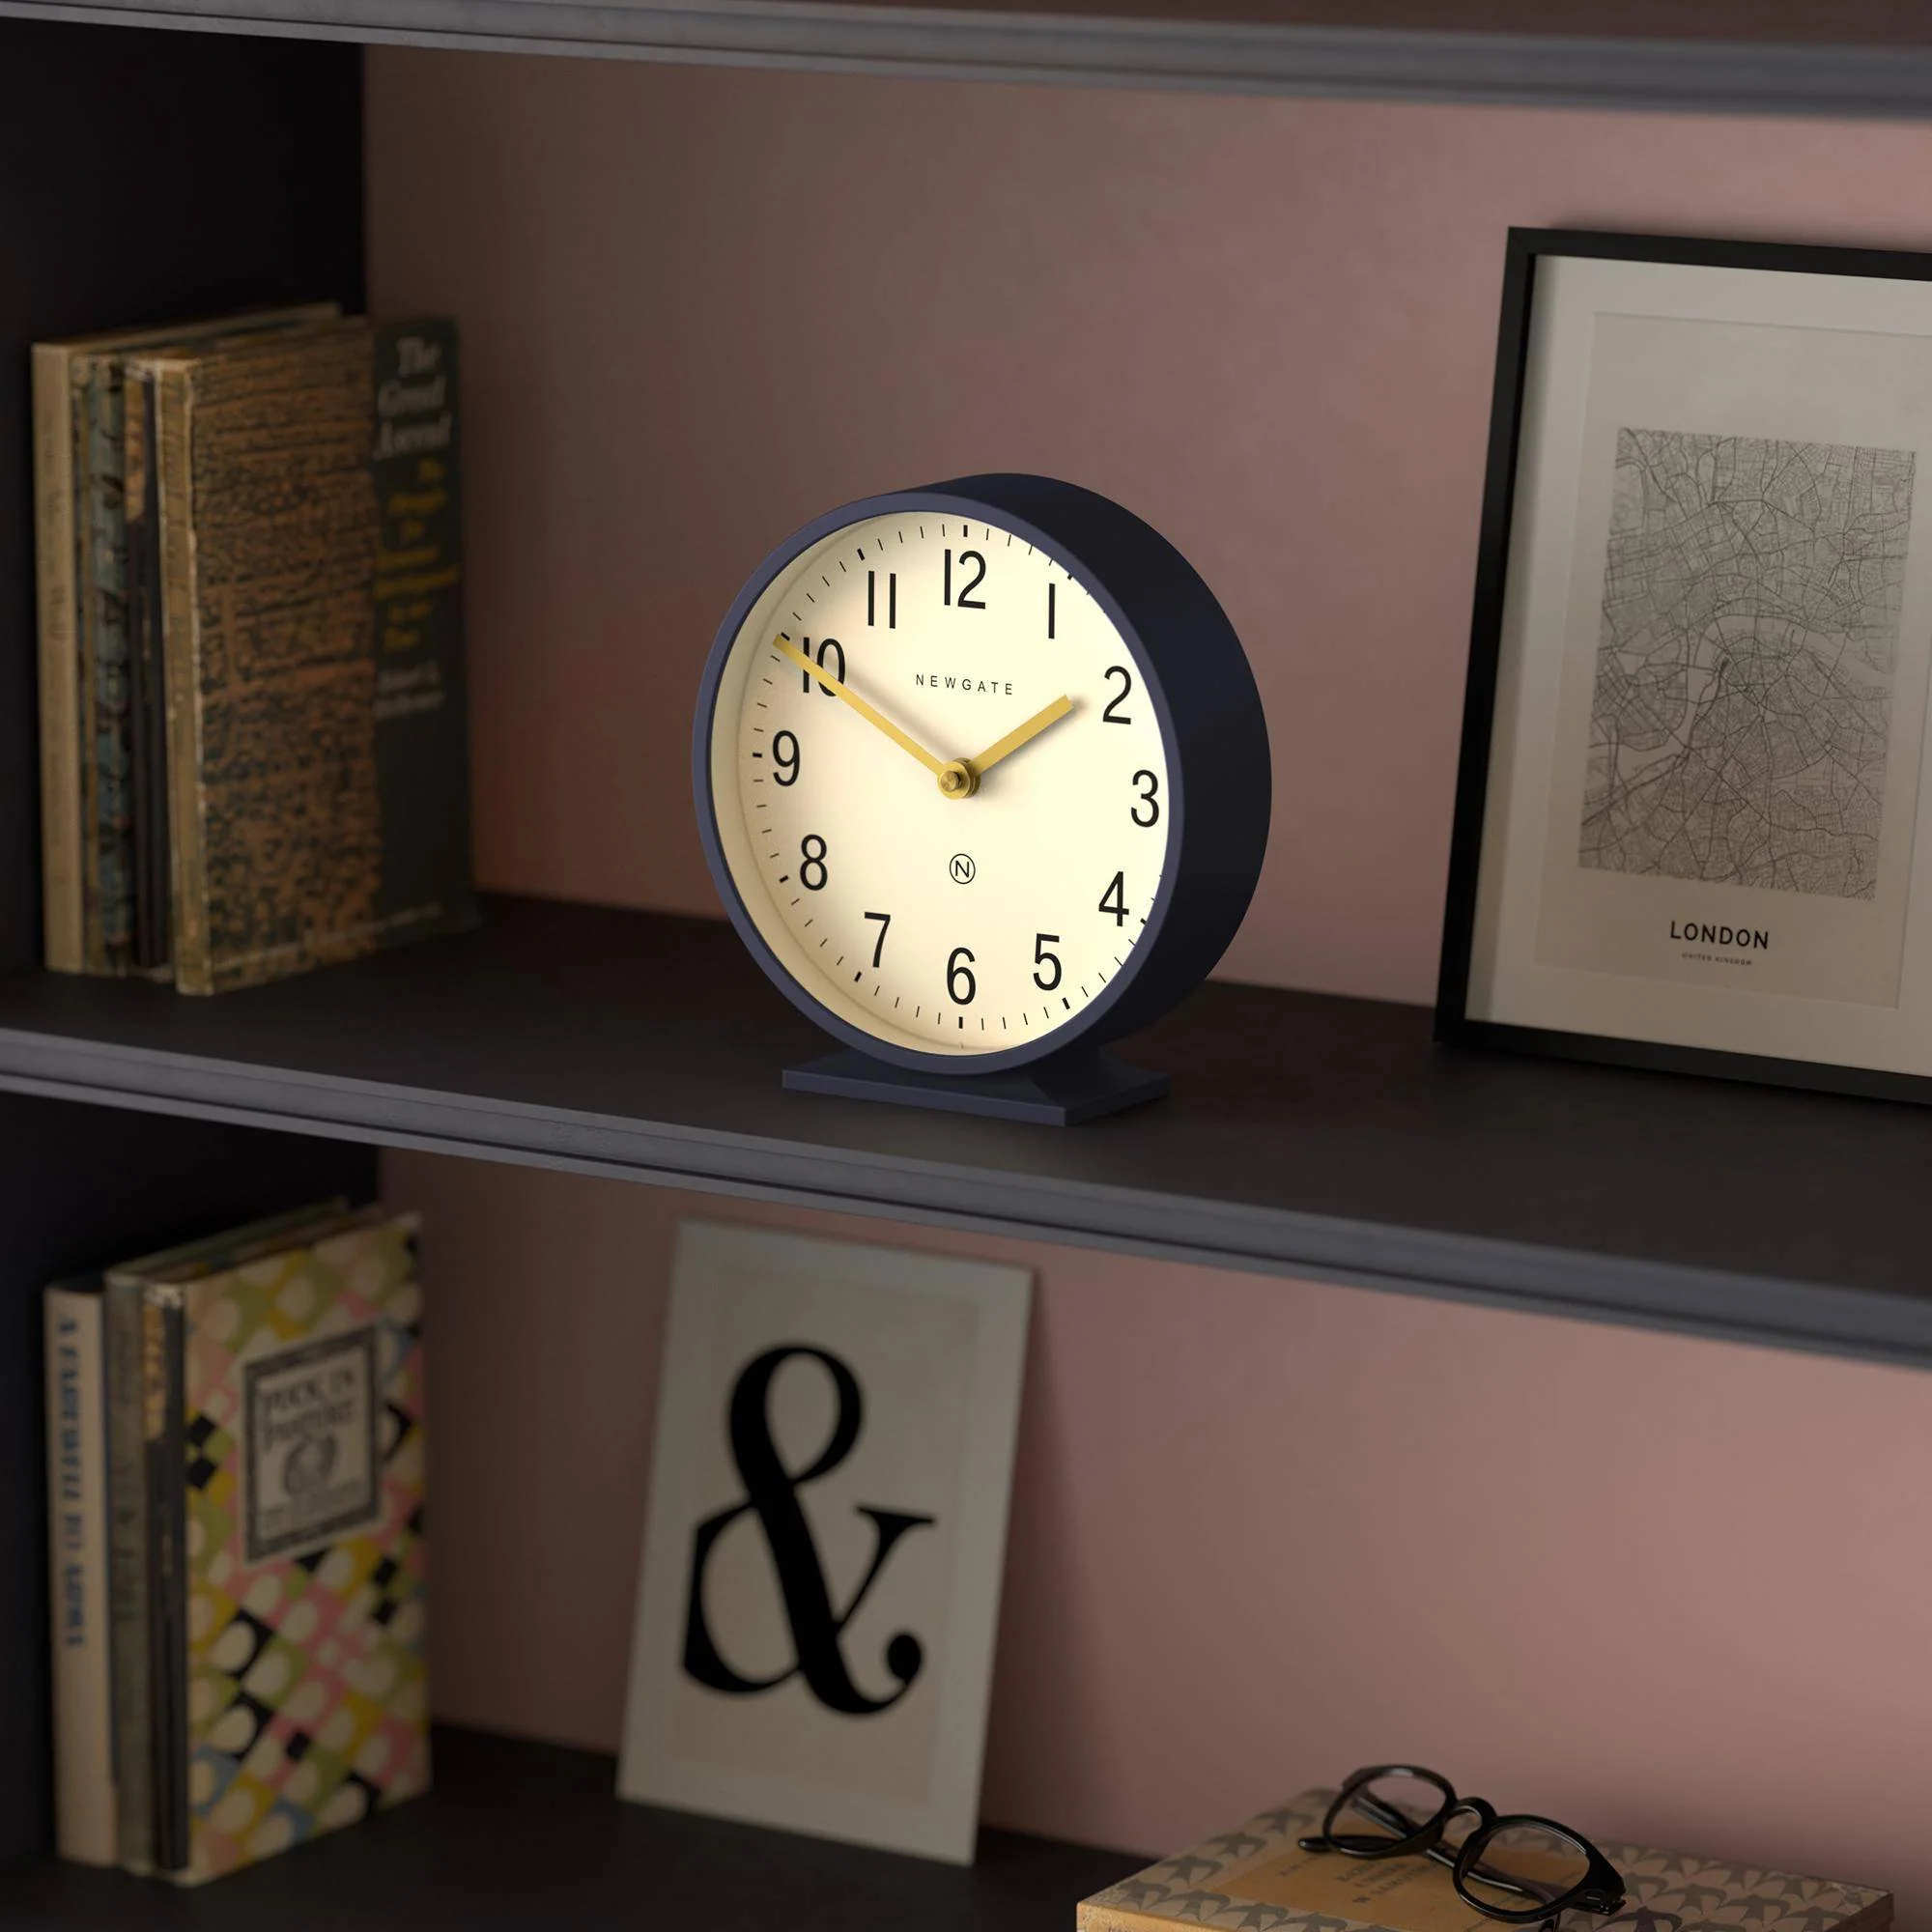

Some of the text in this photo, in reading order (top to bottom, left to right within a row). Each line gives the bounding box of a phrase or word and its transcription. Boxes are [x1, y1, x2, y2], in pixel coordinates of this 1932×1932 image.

[867, 570, 896, 629] 11
[945, 550, 985, 609] 12
[1048, 582, 1056, 639] 1
[803, 637, 846, 696] 10
[916, 673, 1013, 696] NEWGATE
[1103, 666, 1131, 724] 2
[772, 730, 801, 786] 9
[1131, 770, 1159, 828] 3
[800, 835, 829, 891] 8
[1098, 871, 1130, 927] 4
[864, 912, 892, 968] 7
[1033, 933, 1063, 991] 5
[1670, 920, 1769, 950] LONDON
[1681, 952, 1752, 966] UNITED KINGDOM
[947, 947, 977, 1006] 6
[681, 1344, 934, 1717] &
